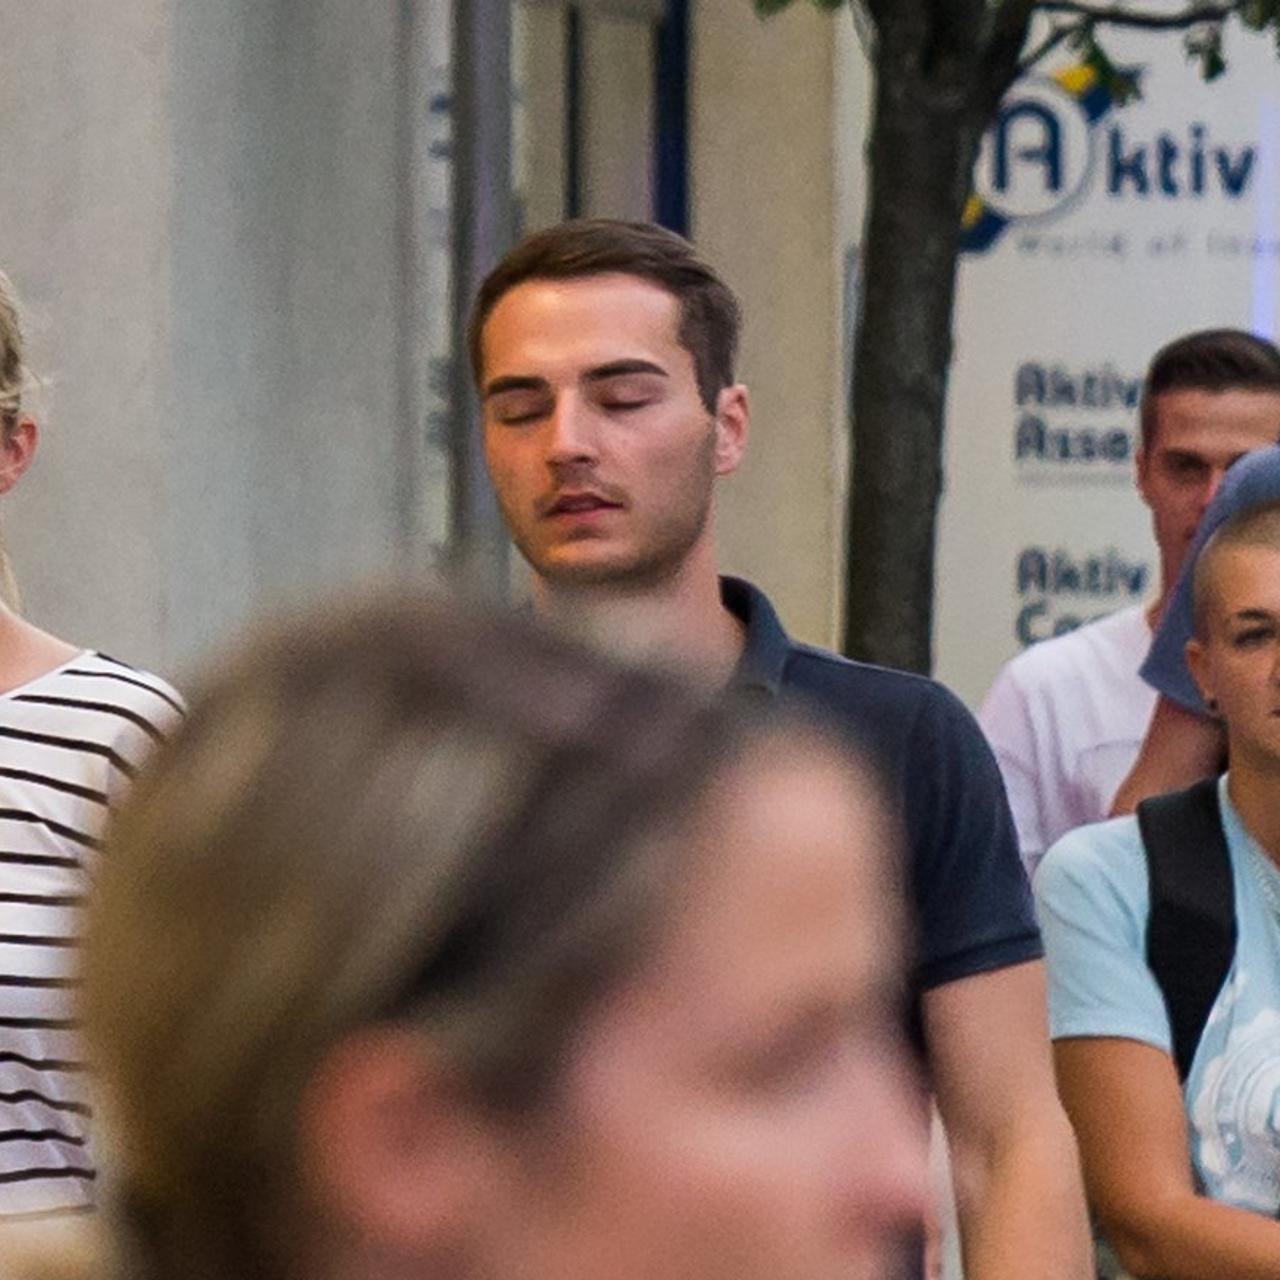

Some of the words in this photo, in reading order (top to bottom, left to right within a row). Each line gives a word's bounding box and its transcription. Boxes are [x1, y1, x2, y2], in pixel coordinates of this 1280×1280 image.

[992, 102, 1255, 197] Aktiv
[1015, 362, 1144, 408] Aktiv
[1017, 547, 1148, 595] Aktiv
